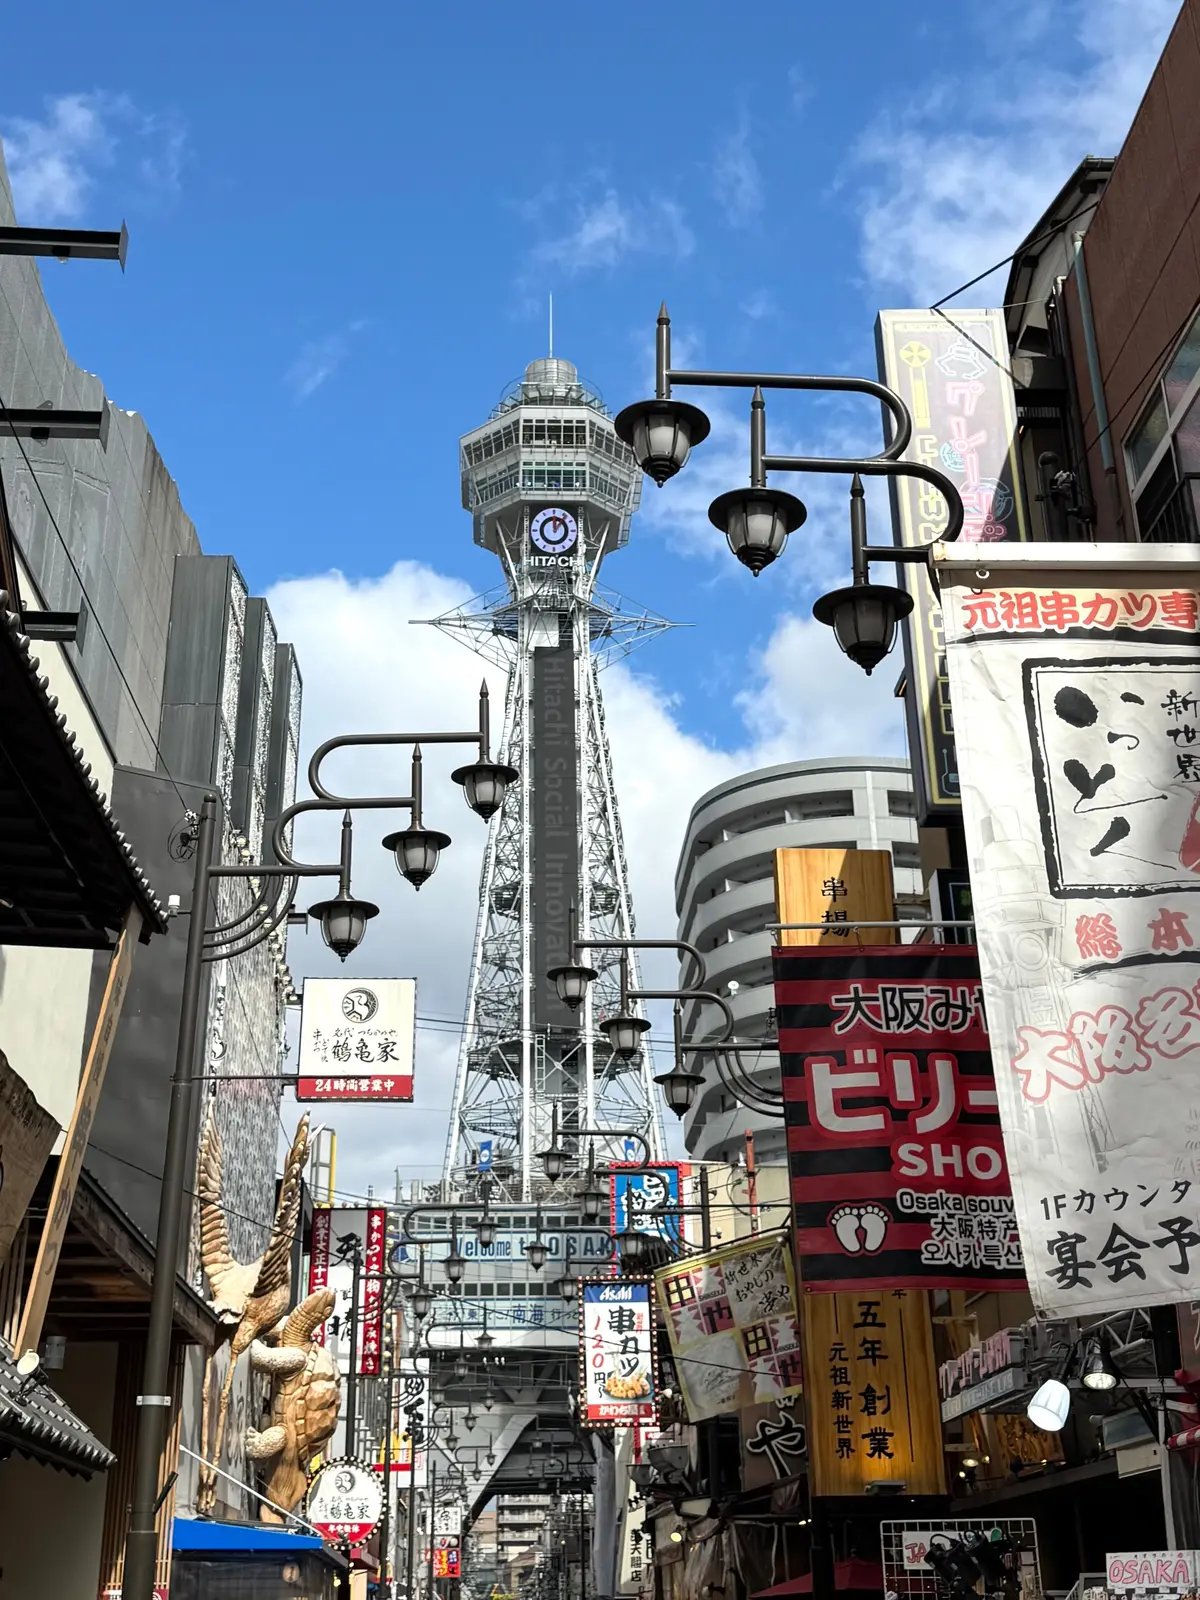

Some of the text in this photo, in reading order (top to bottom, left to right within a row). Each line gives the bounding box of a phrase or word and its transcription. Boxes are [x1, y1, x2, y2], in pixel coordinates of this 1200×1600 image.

[962, 591, 1198, 629] 元祖串カツ専
[543, 657, 570, 1010] Hitachi Social Innovatn
[332, 1037, 400, 1063] 鶴亀家
[315, 1079, 395, 1092] 24時間営業中
[899, 1143, 1001, 1179] SHO
[899, 1190, 1014, 1213] Osaka souv
[1040, 1180, 1192, 1221] 1Fカウンタ
[1045, 1215, 1200, 1290] 宴会予
[599, 1286, 633, 1300] Asahi
[512, 1303, 544, 1323] 南海
[607, 1306, 640, 1377] 串カツ
[829, 1342, 856, 1459] 元祖新世界
[905, 1543, 927, 1563] JA
[1109, 1559, 1192, 1584] OSAKA
